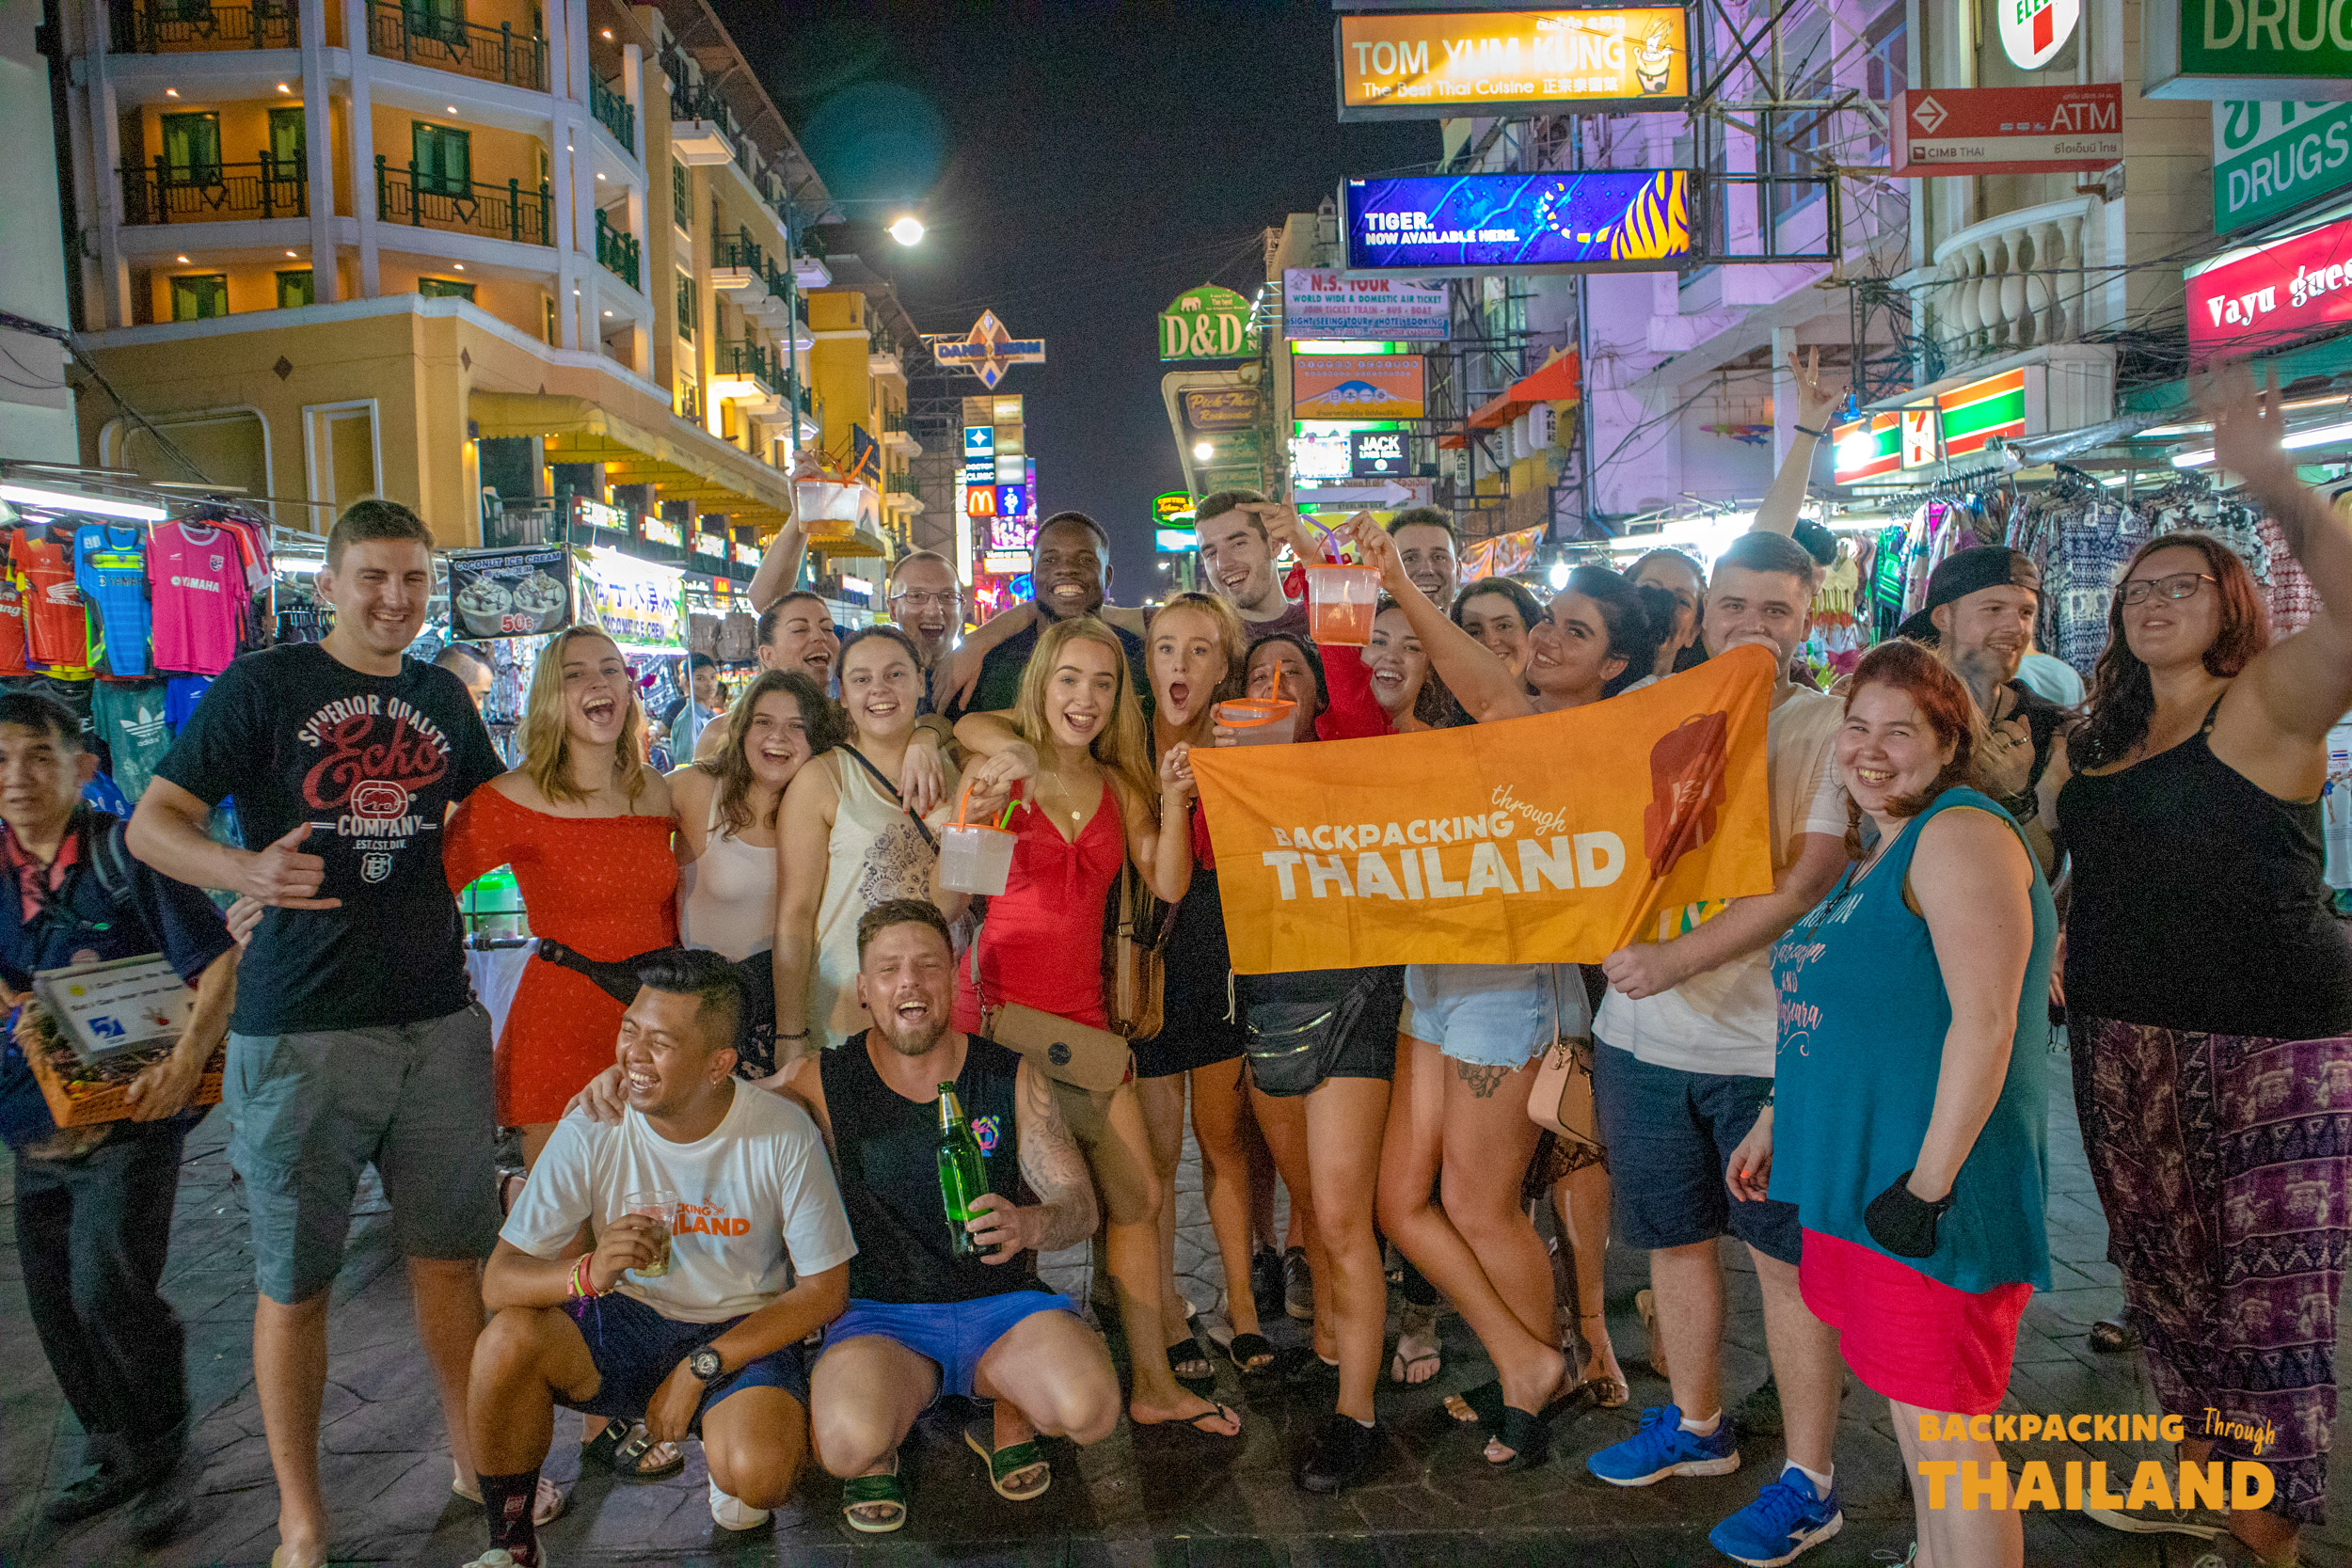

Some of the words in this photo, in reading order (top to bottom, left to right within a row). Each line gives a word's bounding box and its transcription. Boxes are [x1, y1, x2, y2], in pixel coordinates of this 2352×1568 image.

[1353, 40, 1429, 75] TOM
[1442, 37, 1521, 77] YUM
[1534, 34, 1626, 73] KUNG
[1363, 82, 1392, 98] The
[1397, 82, 1432, 98] Best
[1436, 80, 1470, 96] Thai
[1475, 79, 1534, 95] Cuisine
[2049, 102, 2117, 132] ATM
[1929, 147, 1957, 158] CIMB
[1960, 146, 1985, 157] THAI
[2229, 115, 2352, 213] DRUGS
[1364, 212, 1435, 231] TIGER.
[1365, 232, 1398, 245] NOW
[1400, 230, 1477, 245] AVAILABLE
[1478, 229, 1520, 243] HERE.
[1311, 274, 1343, 293] N.S.
[1350, 278, 1391, 293] TOUR
[1293, 294, 1322, 303] WORLD
[1325, 294, 1345, 303] WIDE
[1349, 294, 1355, 303] &
[1359, 294, 1398, 303] DOMESTIC
[1401, 294, 1414, 303] AIR
[1417, 295, 1442, 304] TICKET
[1325, 306, 1352, 314] TICKET
[1354, 306, 1377, 314] TRAIN
[1387, 306, 1402, 314] BUS
[2206, 294, 2277, 328] Vayu
[1379, 318, 1402, 326] HOTEL
[1406, 318, 1444, 326] BOOKING
[1164, 313, 1242, 356] D&D
[1359, 436, 1401, 451] JACK
[966, 472, 994, 482] CLINIC
[454, 558, 504, 571] COCONUT
[505, 557, 523, 566] ICE
[525, 552, 562, 564] CREAM
[108, 576, 143, 586] YAMAH
[182, 576, 220, 593] YAMAHA
[297, 694, 380, 748] SUPERIOR
[387, 697, 451, 755] QUALITY
[137, 736, 160, 747] adidas
[1491, 784, 1567, 836] through
[337, 815, 423, 837] COMPANY
[1272, 810, 1515, 852] BACKPACKING
[1263, 831, 1626, 900] THAILAND
[1782, 971, 1798, 993] AND
[703, 1195, 726, 1215] through
